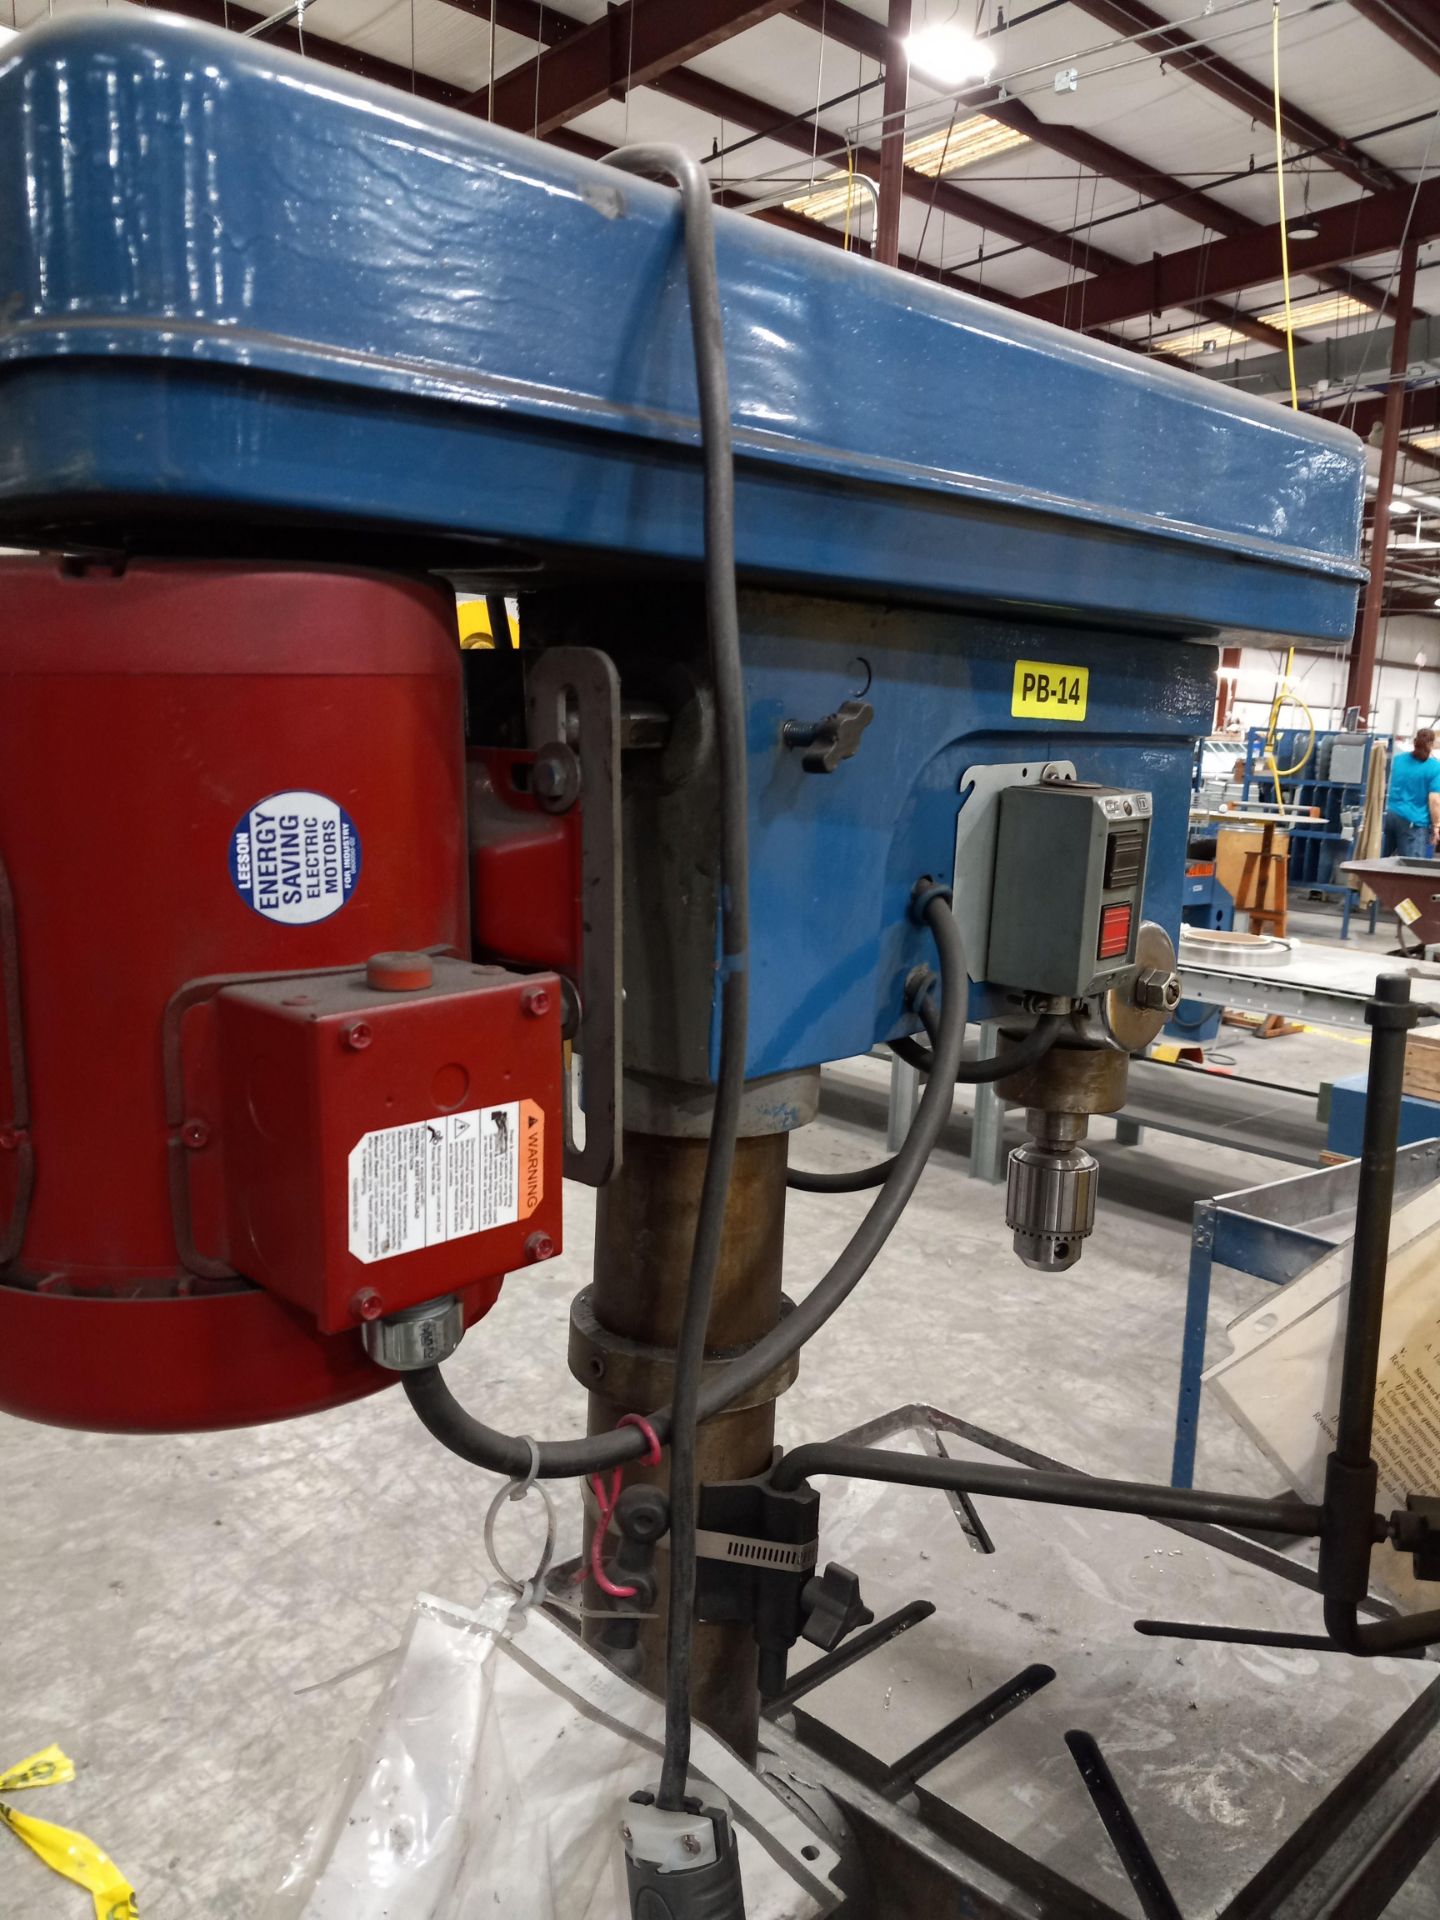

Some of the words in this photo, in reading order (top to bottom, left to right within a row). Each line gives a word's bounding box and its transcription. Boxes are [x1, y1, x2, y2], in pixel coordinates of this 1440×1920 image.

[1022, 672, 1080, 705] PB-14
[236, 832, 251, 889] LEESON
[255, 811, 279, 910] ENERGY
[279, 814, 302, 905] SAVING
[303, 817, 320, 899] ELECTRIC
[322, 820, 338, 894] MOTORS
[342, 823, 351, 870] INDUSTRY
[526, 1132, 539, 1208] WARNING
